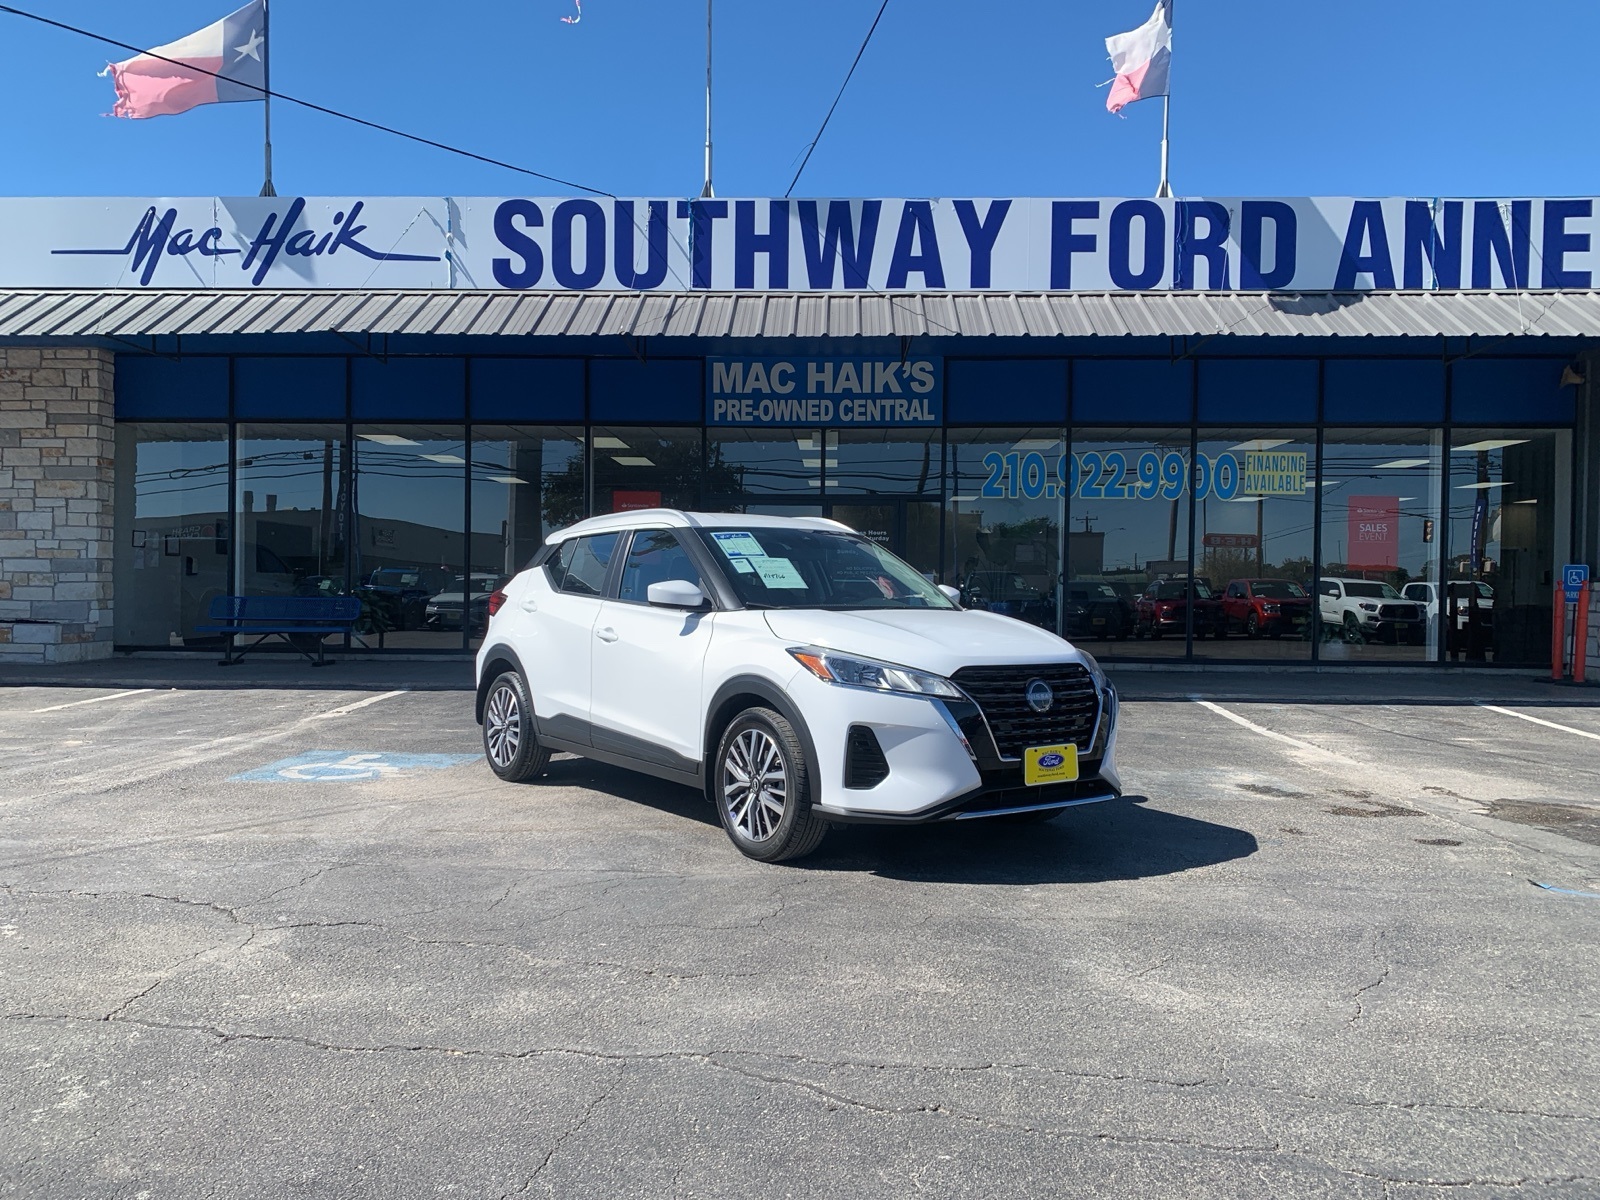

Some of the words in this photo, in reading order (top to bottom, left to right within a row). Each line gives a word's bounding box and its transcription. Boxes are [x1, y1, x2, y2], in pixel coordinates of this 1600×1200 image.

[51, 206, 240, 286] Mac
[242, 197, 441, 286] Haik
[492, 198, 1011, 291] SOUTHWAY
[1049, 198, 1298, 291] FORD
[1334, 198, 1593, 290] ANNE
[712, 361, 796, 394] MAC
[807, 361, 935, 394] HAIK'S
[713, 399, 834, 422] PRE-OWNED
[839, 399, 935, 422] CENTRAL
[1246, 454, 1305, 473] FINANCING
[981, 451, 1240, 501] 210.922.9900
[1245, 474, 1305, 493] AVAILABLE
[1359, 523, 1388, 532] SALES
[1359, 532, 1388, 541] EVENT
[1565, 591, 1580, 599] ARKI
[1043, 755, 1060, 766] Ford
